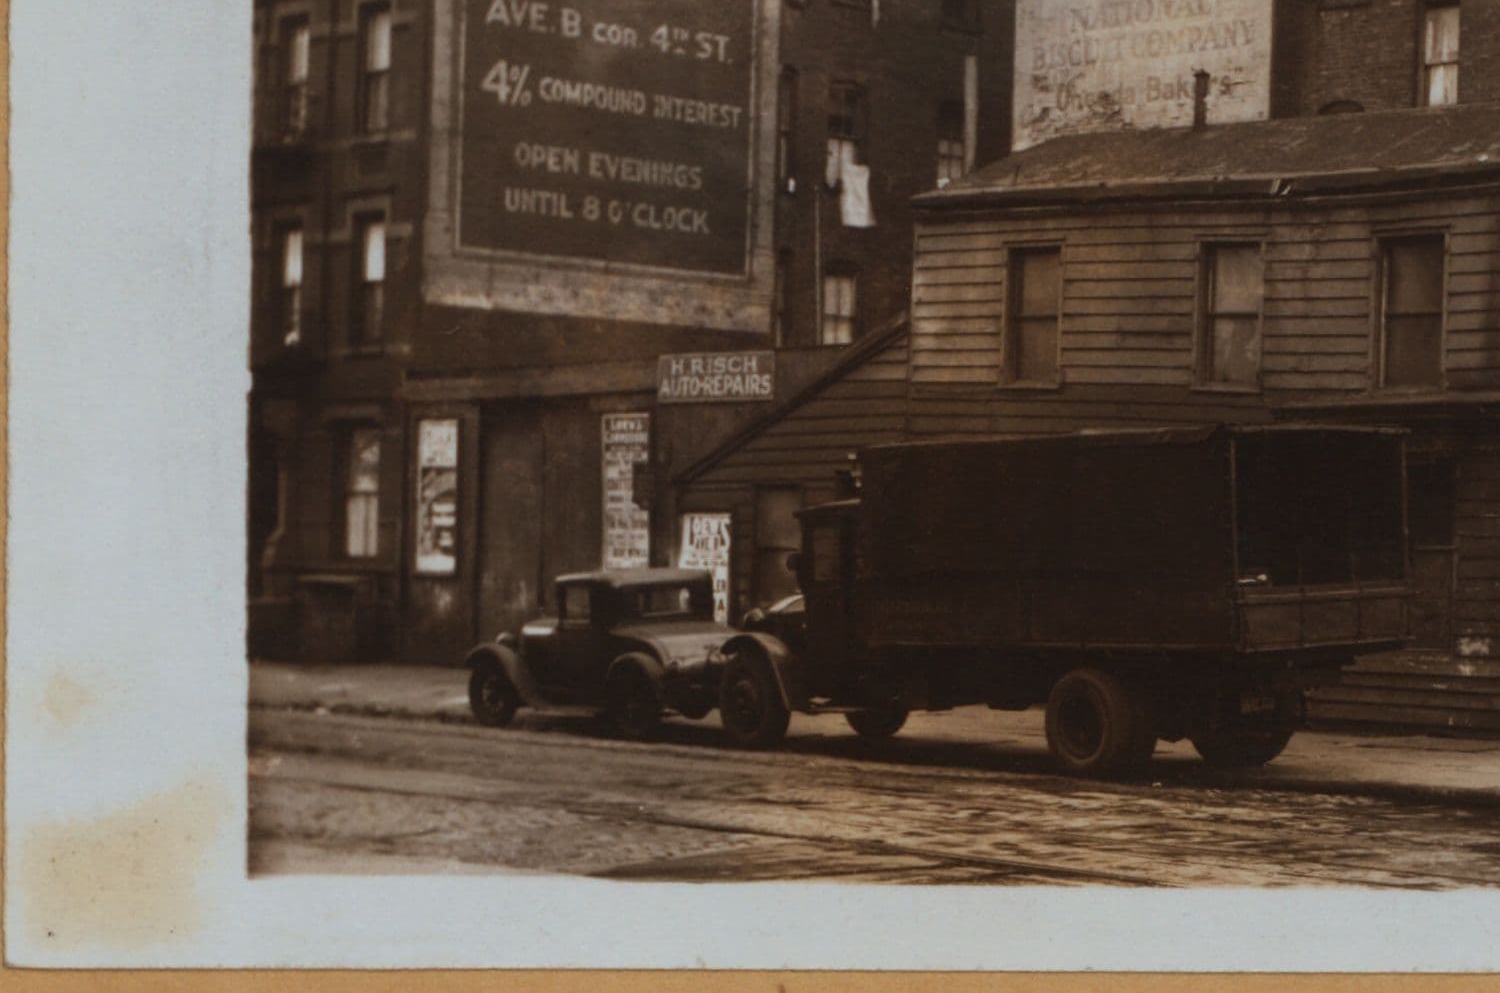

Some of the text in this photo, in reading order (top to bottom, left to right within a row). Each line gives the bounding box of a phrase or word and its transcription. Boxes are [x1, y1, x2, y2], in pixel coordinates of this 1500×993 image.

[560, 7, 582, 38] B
[1032, 19, 1256, 72] BISCUIT COMPANY
[481, 59, 742, 128] 4% COMPOUND INTEREST
[1146, 72, 1234, 103] Bakrs
[514, 142, 703, 190] OPEN EVENINGS
[504, 187, 710, 234] UNTIL 8 O'CLOCK
[691, 356, 759, 375] RISCH
